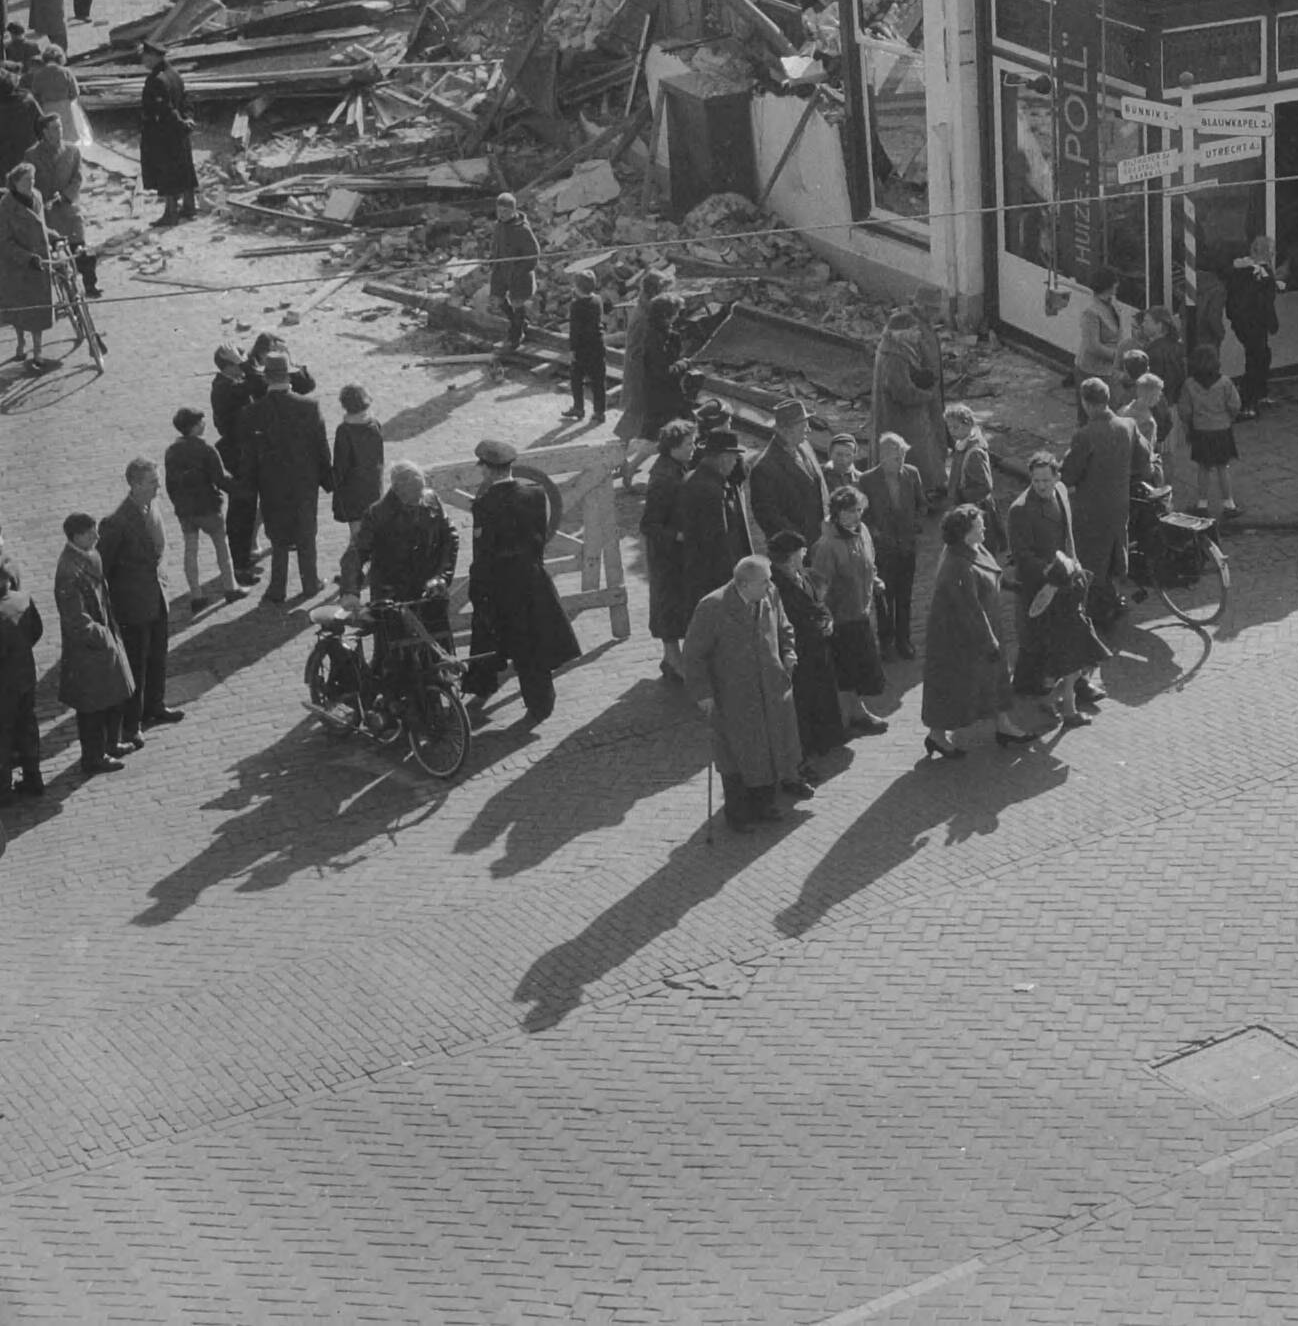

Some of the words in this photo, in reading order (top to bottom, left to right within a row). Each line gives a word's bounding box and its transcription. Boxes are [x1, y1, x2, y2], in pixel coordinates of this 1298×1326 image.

[1125, 104, 1160, 118] BUNNIK
[1201, 117, 1259, 129] BLAUWKAPEL
[1205, 142, 1247, 159] UTRECHT
[1074, 186, 1091, 266] HUIZE
